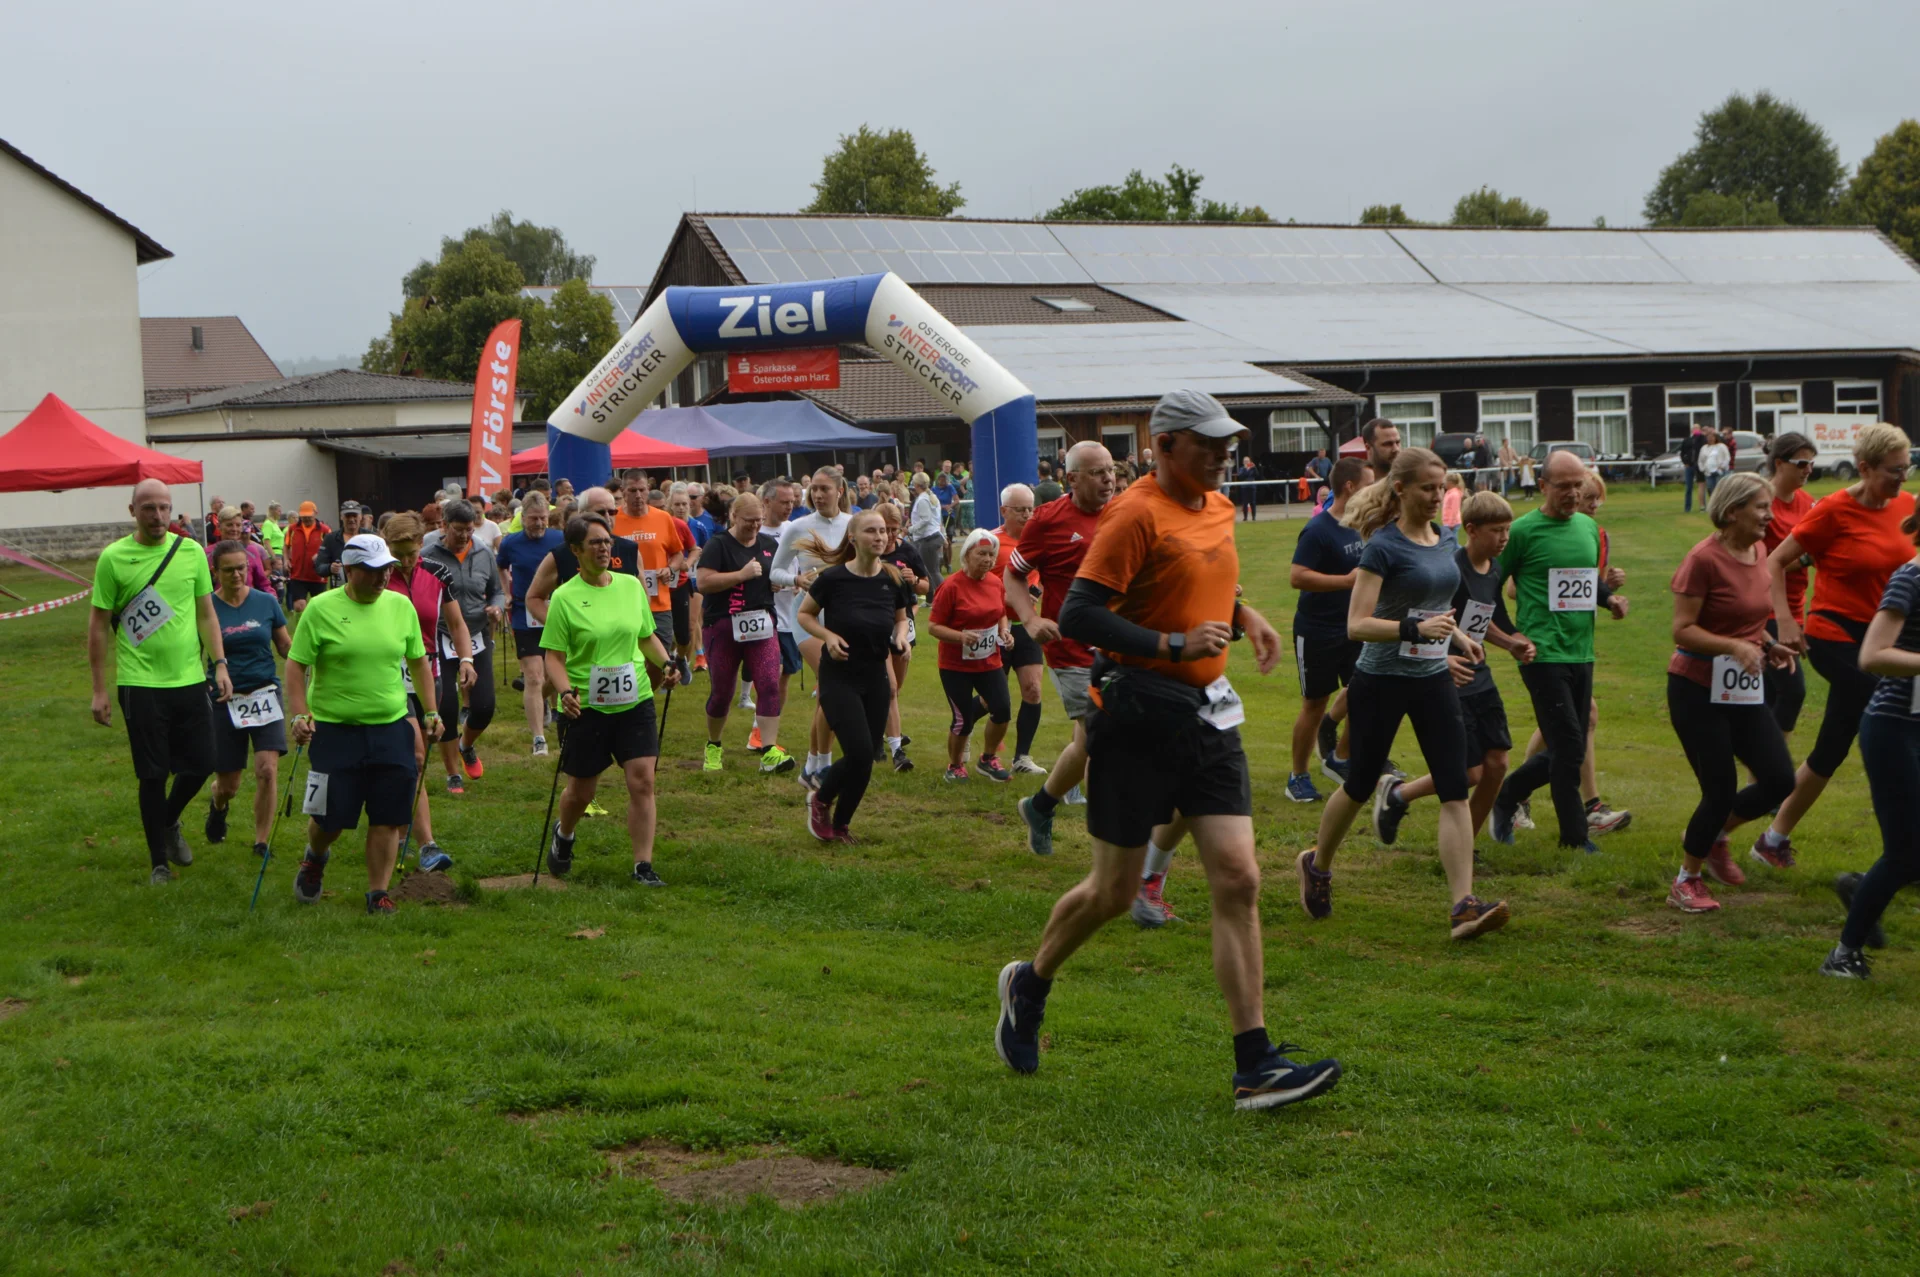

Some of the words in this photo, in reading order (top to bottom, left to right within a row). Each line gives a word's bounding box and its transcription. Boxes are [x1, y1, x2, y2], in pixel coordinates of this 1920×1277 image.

[719, 291, 827, 338] Ziel
[918, 322, 971, 367] OSTERODE
[586, 332, 655, 406] INTERSPORT
[587, 340, 631, 387] OSTERODE
[753, 363, 797, 375] Sparkasse
[884, 334, 962, 406] STRICKER
[899, 325, 978, 394] INTERSPORT
[591, 349, 666, 423] STRICKER
[753, 375, 792, 384] Osterode
[809, 373, 830, 382] Harz
[482, 341, 511, 455] Förste
[1558, 580, 1592, 598] 226
[127, 600, 161, 634] 218
[739, 618, 765, 633] 037
[1466, 614, 1490, 633] 22
[970, 634, 994, 652] 049
[597, 674, 632, 694] 215
[238, 699, 273, 719] 244
[308, 783, 319, 802] 7
